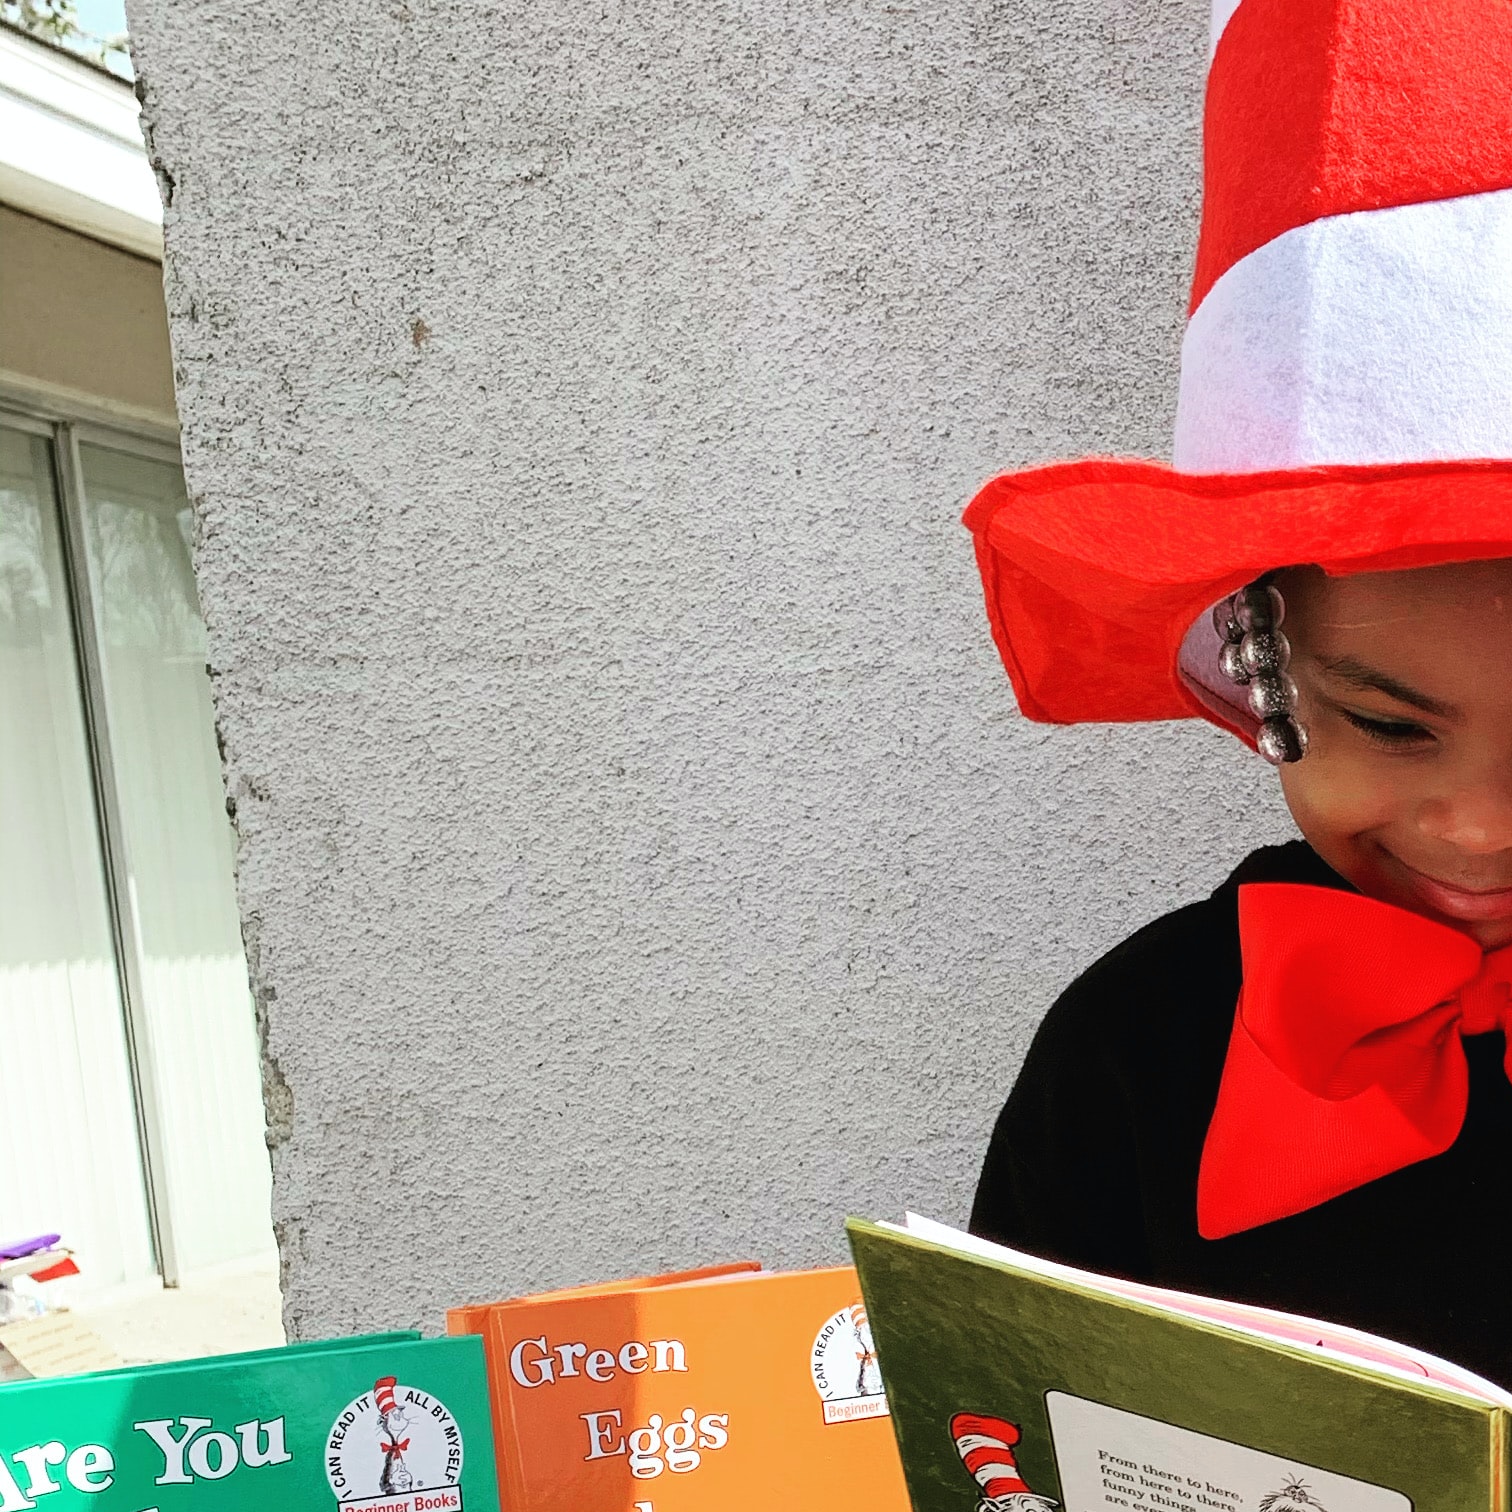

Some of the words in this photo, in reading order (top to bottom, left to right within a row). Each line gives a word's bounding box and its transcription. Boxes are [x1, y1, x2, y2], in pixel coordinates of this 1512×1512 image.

[834, 1313, 847, 1326] IT
[814, 1324, 835, 1357] READ
[509, 1335, 689, 1388] Green
[814, 1362, 829, 1389] CAN
[355, 1396, 370, 1413] IT
[404, 1390, 430, 1410] ALL
[825, 1390, 834, 1398] I
[430, 1405, 451, 1423] BY
[827, 1401, 881, 1418] Beginner
[329, 1411, 356, 1450] READ
[133, 1414, 293, 1486] You
[443, 1425, 461, 1484] MYSELF
[579, 1406, 730, 1480] Eggs
[329, 1456, 347, 1488] CAN
[1098, 1449, 1138, 1470] From
[1142, 1464, 1182, 1483] there
[1186, 1476, 1202, 1489] to
[341, 1489, 353, 1499] I
[1100, 1464, 1135, 1482] from
[1139, 1475, 1173, 1494] here
[1177, 1488, 1192, 1500] to
[1102, 1478, 1146, 1500] funny
[413, 1493, 458, 1512] Books
[1104, 1494, 1129, 1507] are
